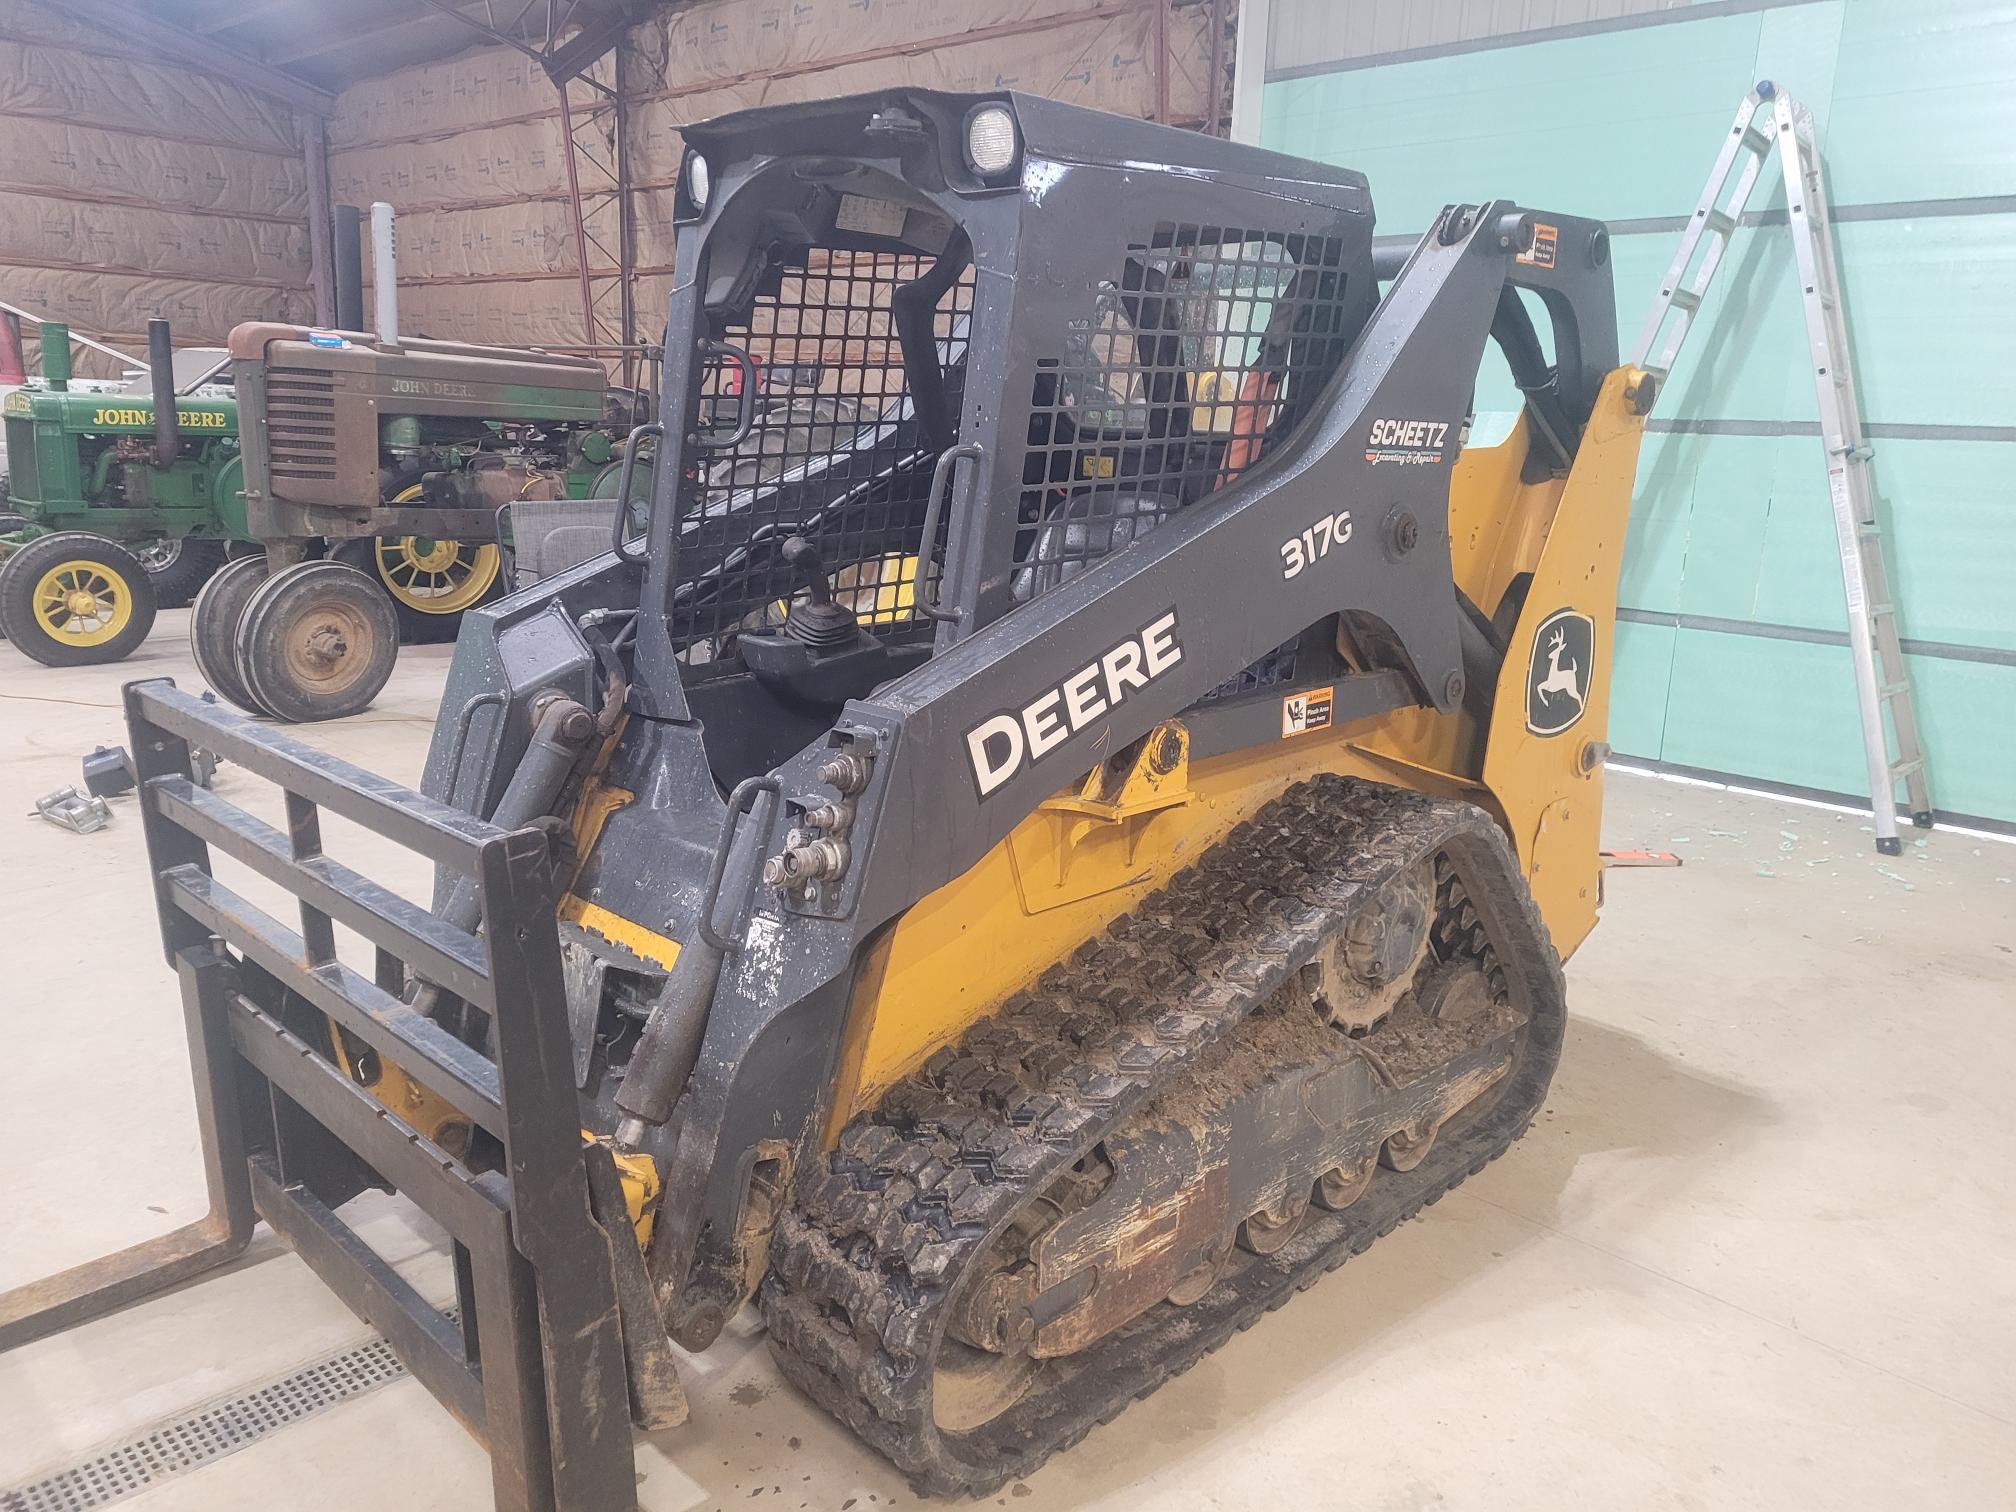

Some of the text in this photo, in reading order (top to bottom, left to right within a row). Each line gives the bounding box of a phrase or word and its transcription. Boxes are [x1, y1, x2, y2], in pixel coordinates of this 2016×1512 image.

[391, 380, 477, 397] JOHN DEER
[93, 409, 226, 427] JOHN EERE
[1369, 419, 1449, 447] SCHEETZ
[1280, 510, 1353, 579] 317G
[966, 611, 1182, 796] DEERE
